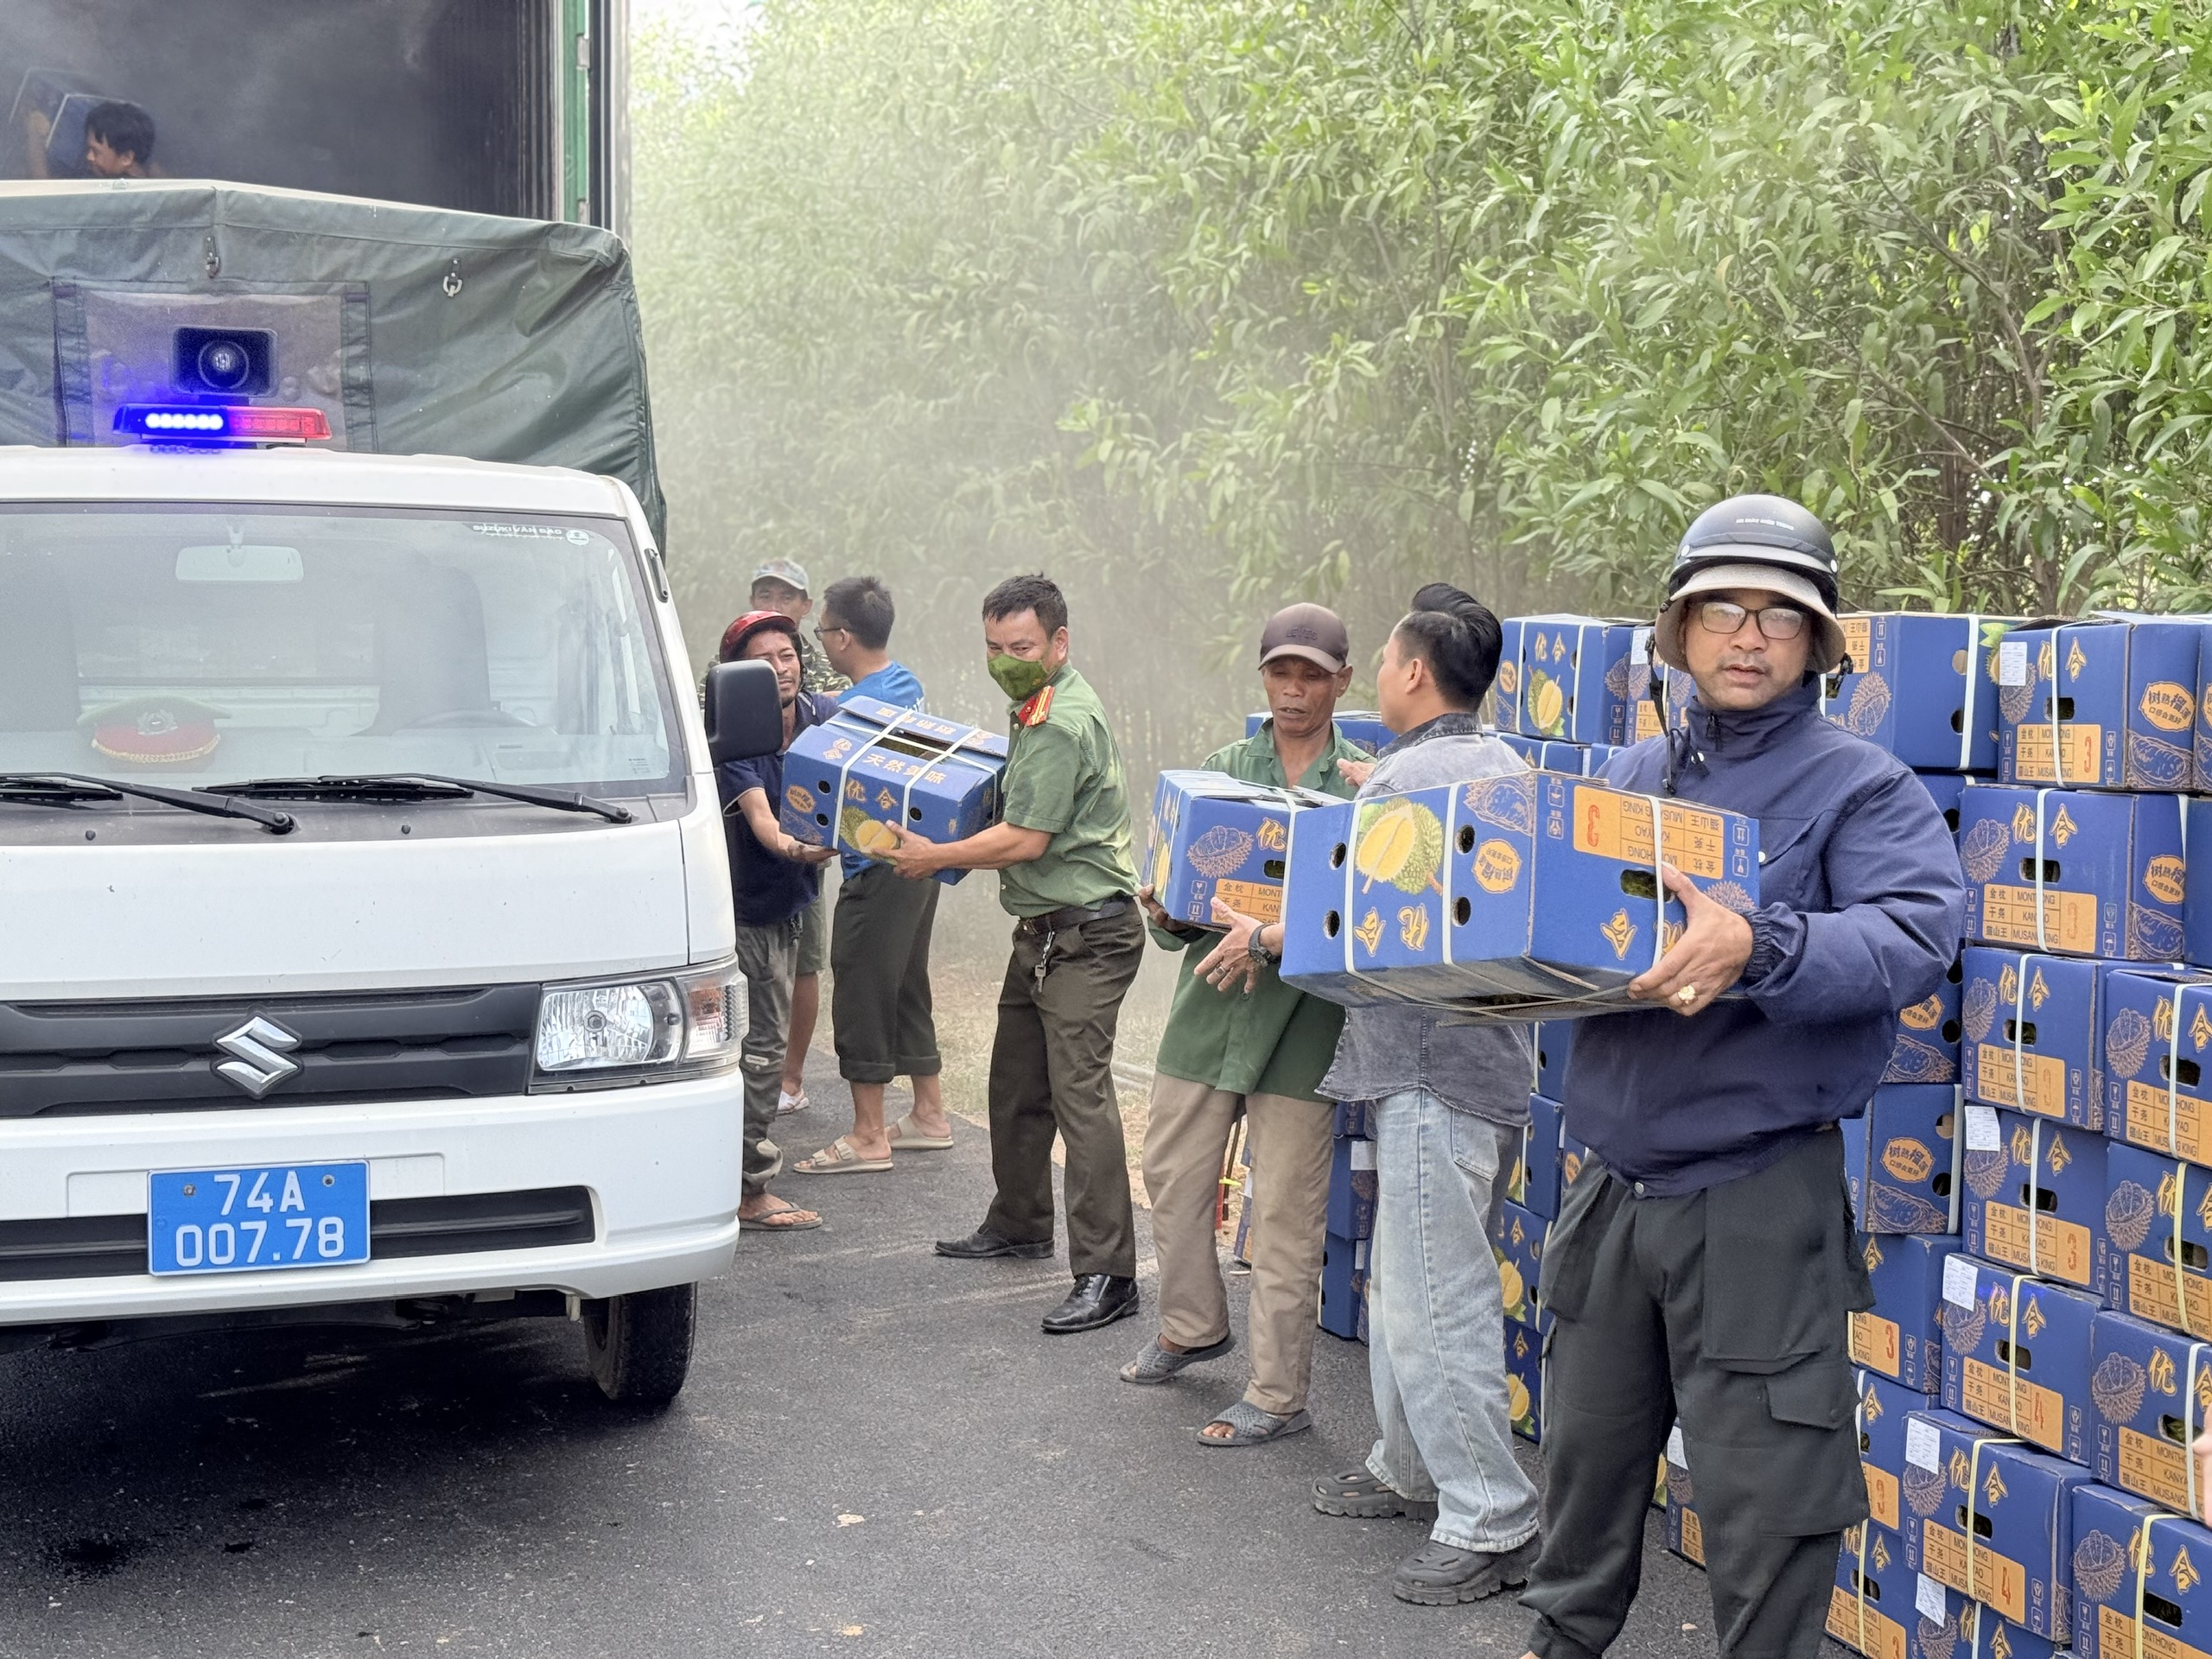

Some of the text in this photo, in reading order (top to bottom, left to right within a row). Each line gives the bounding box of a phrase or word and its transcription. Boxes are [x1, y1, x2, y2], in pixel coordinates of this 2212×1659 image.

[2037, 637, 2087, 683] 优合
[2042, 728, 2070, 740] MONONG
[845, 778, 899, 810] 优合
[1623, 800, 1682, 823] MUSAG KING
[1256, 817, 1287, 852] 优
[1587, 804, 1599, 847] 3
[1635, 825, 1670, 842] KAYAO
[2012, 803, 2077, 849] 优合
[1628, 846, 1677, 865] MOHONG
[2151, 864, 2184, 884] 树熟榴
[1258, 887, 1283, 898] MONT
[2017, 891, 2056, 905] MONTONG
[1262, 903, 1281, 913] KAN
[2022, 911, 2050, 923] KANO
[1354, 903, 1429, 957] 优合
[2012, 929, 2038, 941] MUSAN
[1999, 963, 2050, 1012] 优合
[2152, 995, 2212, 1052] 优合
[2158, 1092, 2195, 1114] MOHONG
[2163, 1116, 2189, 1134] KYAO
[2010, 1124, 2072, 1176] 优合
[2154, 1134, 2182, 1153] MUSG
[213, 1171, 306, 1216] 74A
[175, 1216, 345, 1267] 007.78
[2067, 1233, 2076, 1270] 3
[2013, 1249, 2039, 1267] MUSAG
[1989, 1281, 2047, 1339] 优合
[1885, 1324, 1894, 1359] 3
[1993, 1371, 2027, 1395] MONTONG
[1862, 1382, 1884, 1426] 合
[1997, 1392, 2022, 1411] KANO
[2034, 1392, 2044, 1430] 4
[1990, 1409, 2012, 1426] MUSAN
[2156, 1445, 2201, 1471] MONTHG
[1949, 1446, 2008, 1508] 优合
[2164, 1468, 2188, 1485] KANYA
[2153, 1484, 2187, 1507] MUSANG
[2128, 1526, 2200, 1595] 优合
[1950, 1573, 1977, 1595] MUSAG
[2001, 1566, 2012, 1605] 4
[2142, 1628, 2177, 1655] ONTHONG
